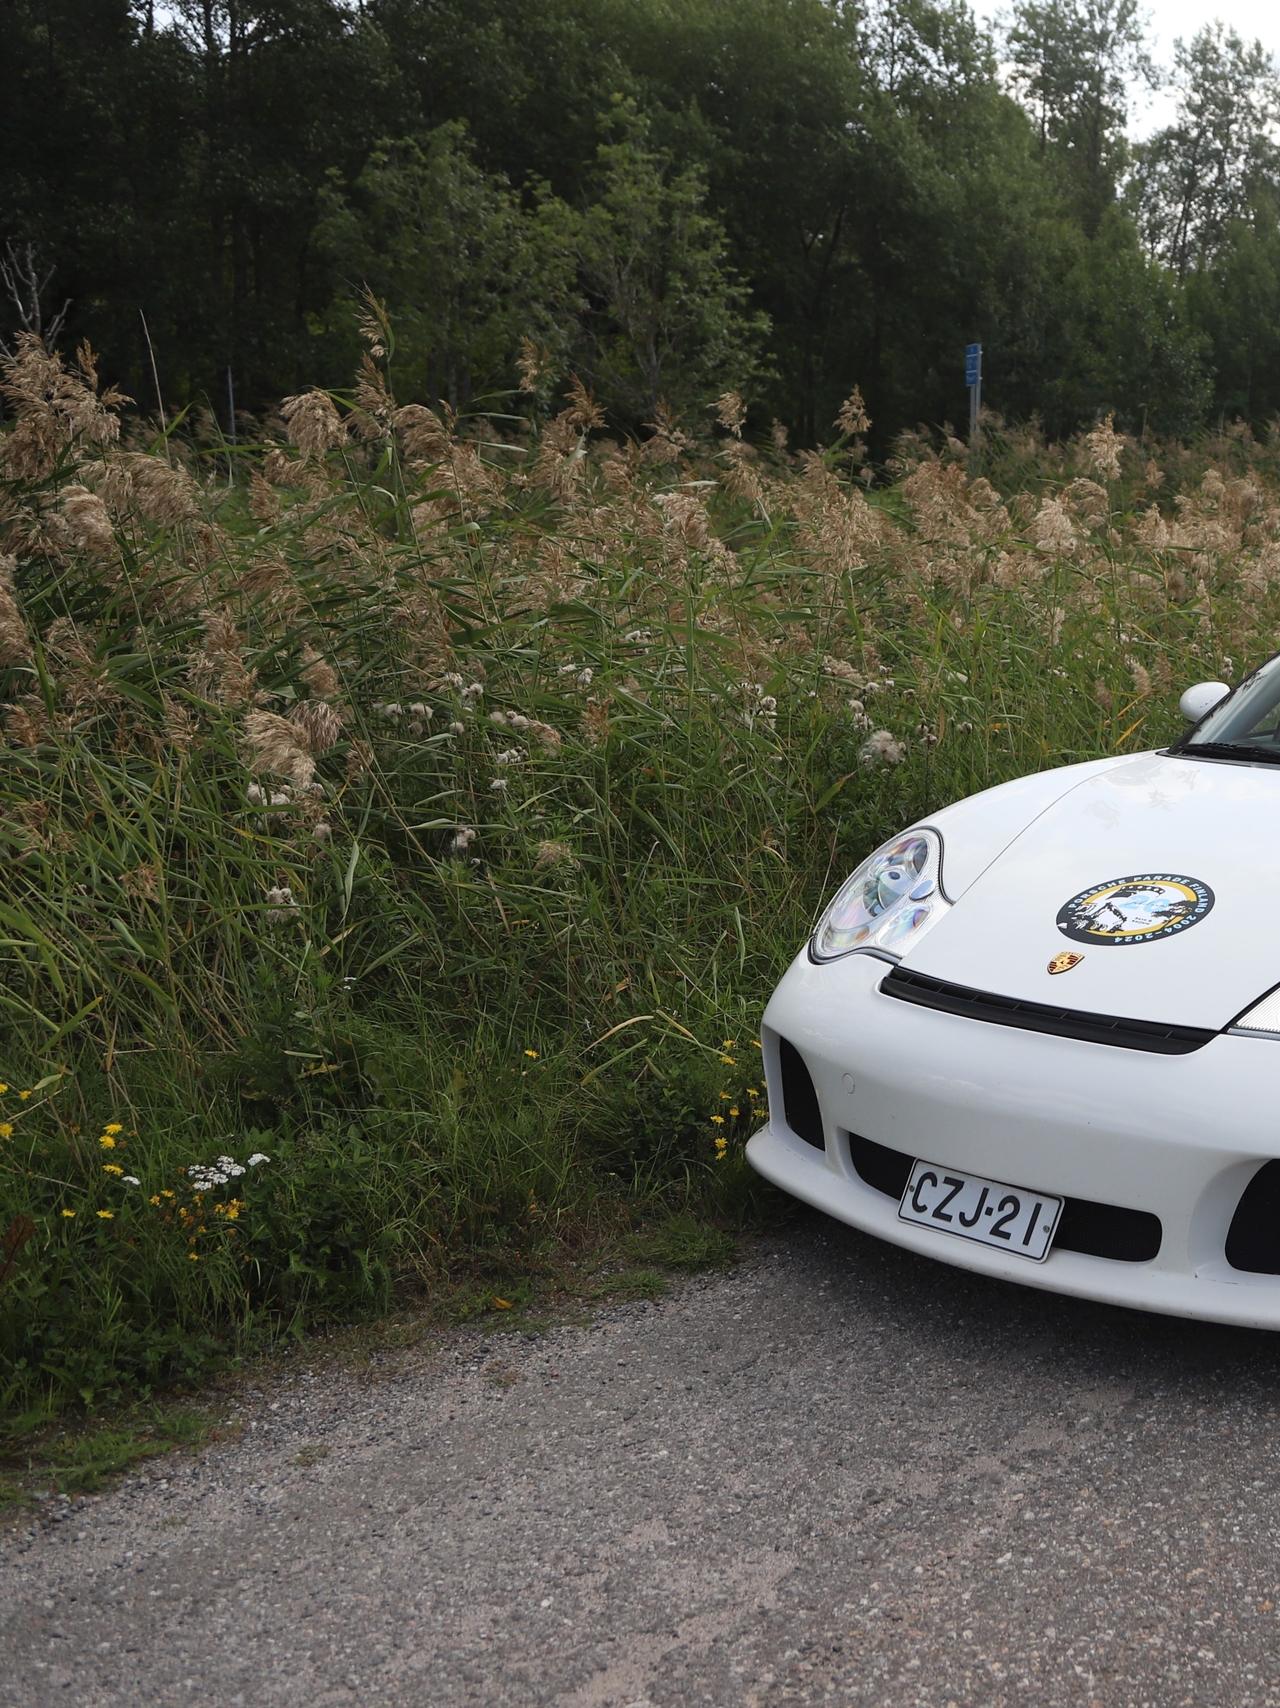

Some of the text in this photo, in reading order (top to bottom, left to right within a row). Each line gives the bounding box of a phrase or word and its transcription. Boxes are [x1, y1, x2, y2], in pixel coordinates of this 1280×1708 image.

[1068, 875, 1208, 913] PORSCHE PARADE FINLAND
[1119, 894, 1171, 912] 20
[912, 1171, 1042, 1246] CZJ-21
